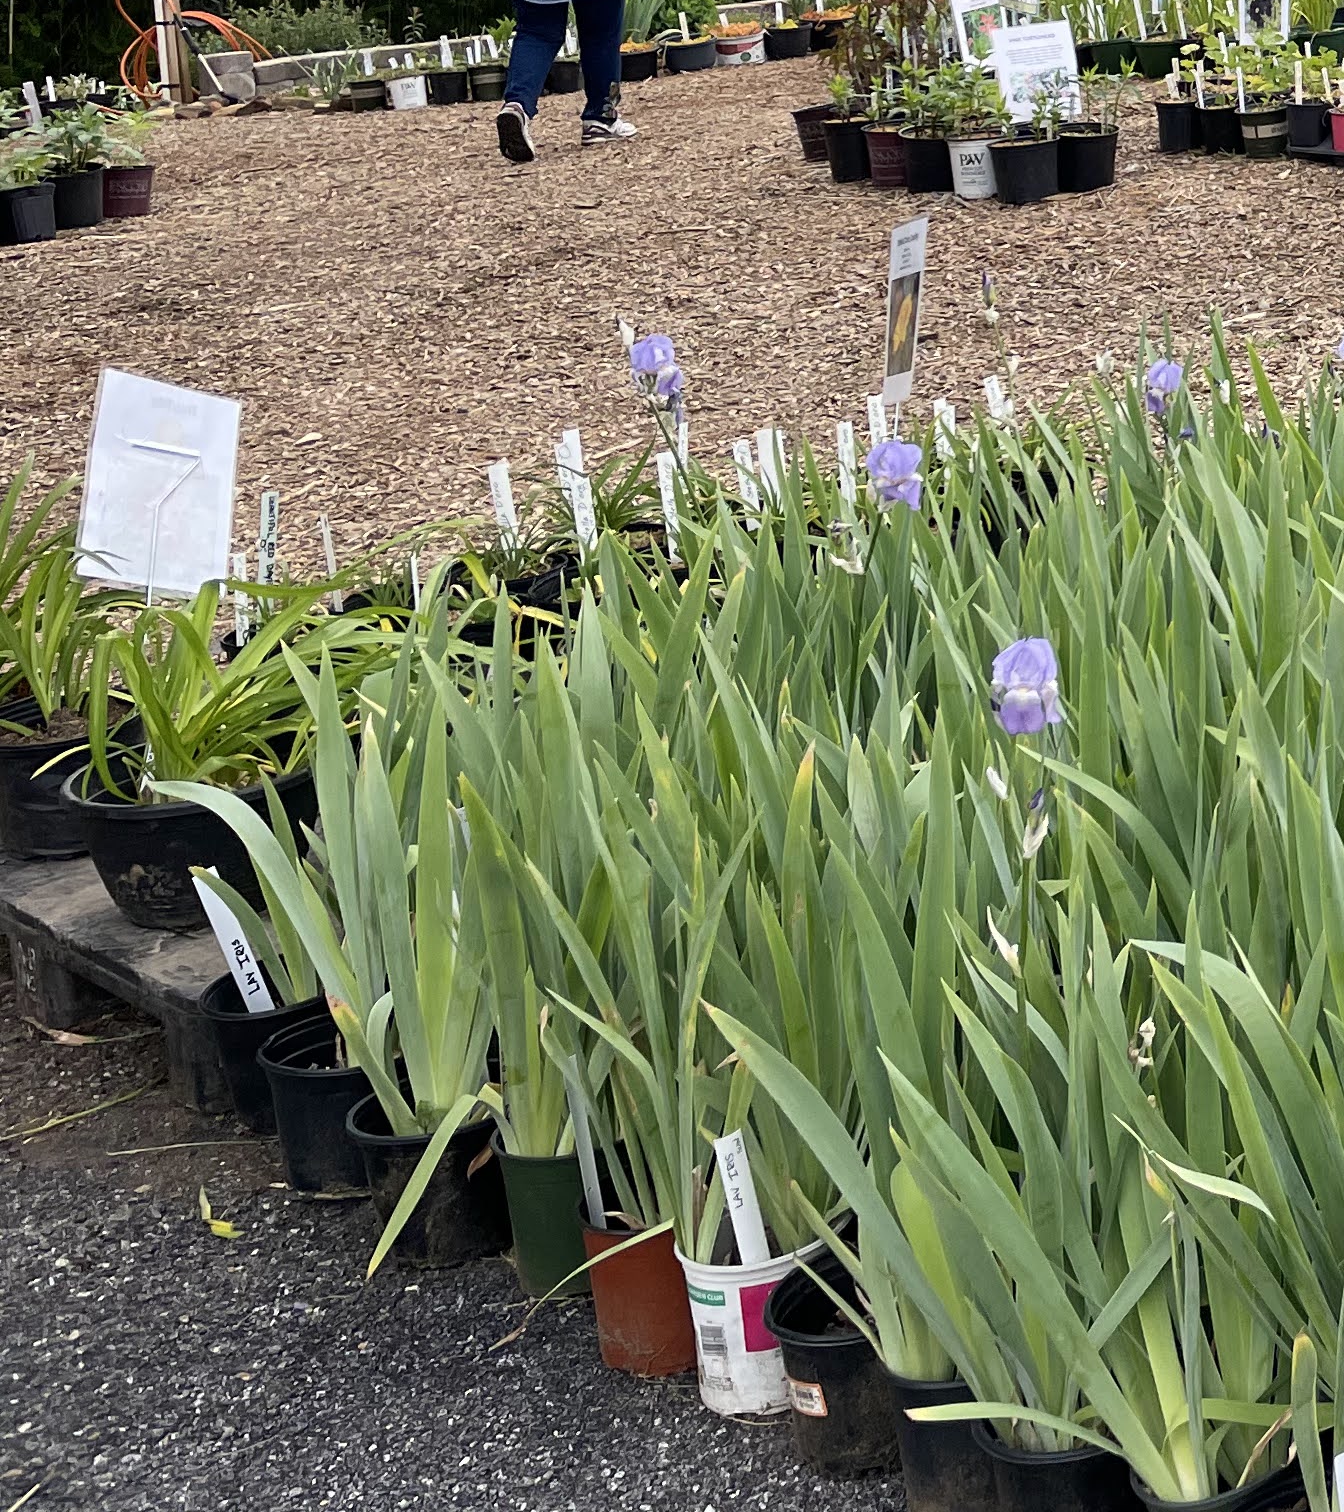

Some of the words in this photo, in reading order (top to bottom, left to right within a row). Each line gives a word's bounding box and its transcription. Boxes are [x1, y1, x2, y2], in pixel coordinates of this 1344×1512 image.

[245, 971, 261, 996] LAV
[724, 1152, 739, 1182] IRIS
[730, 1186, 744, 1210] LAV
[706, 1293, 724, 1301] CLUB
